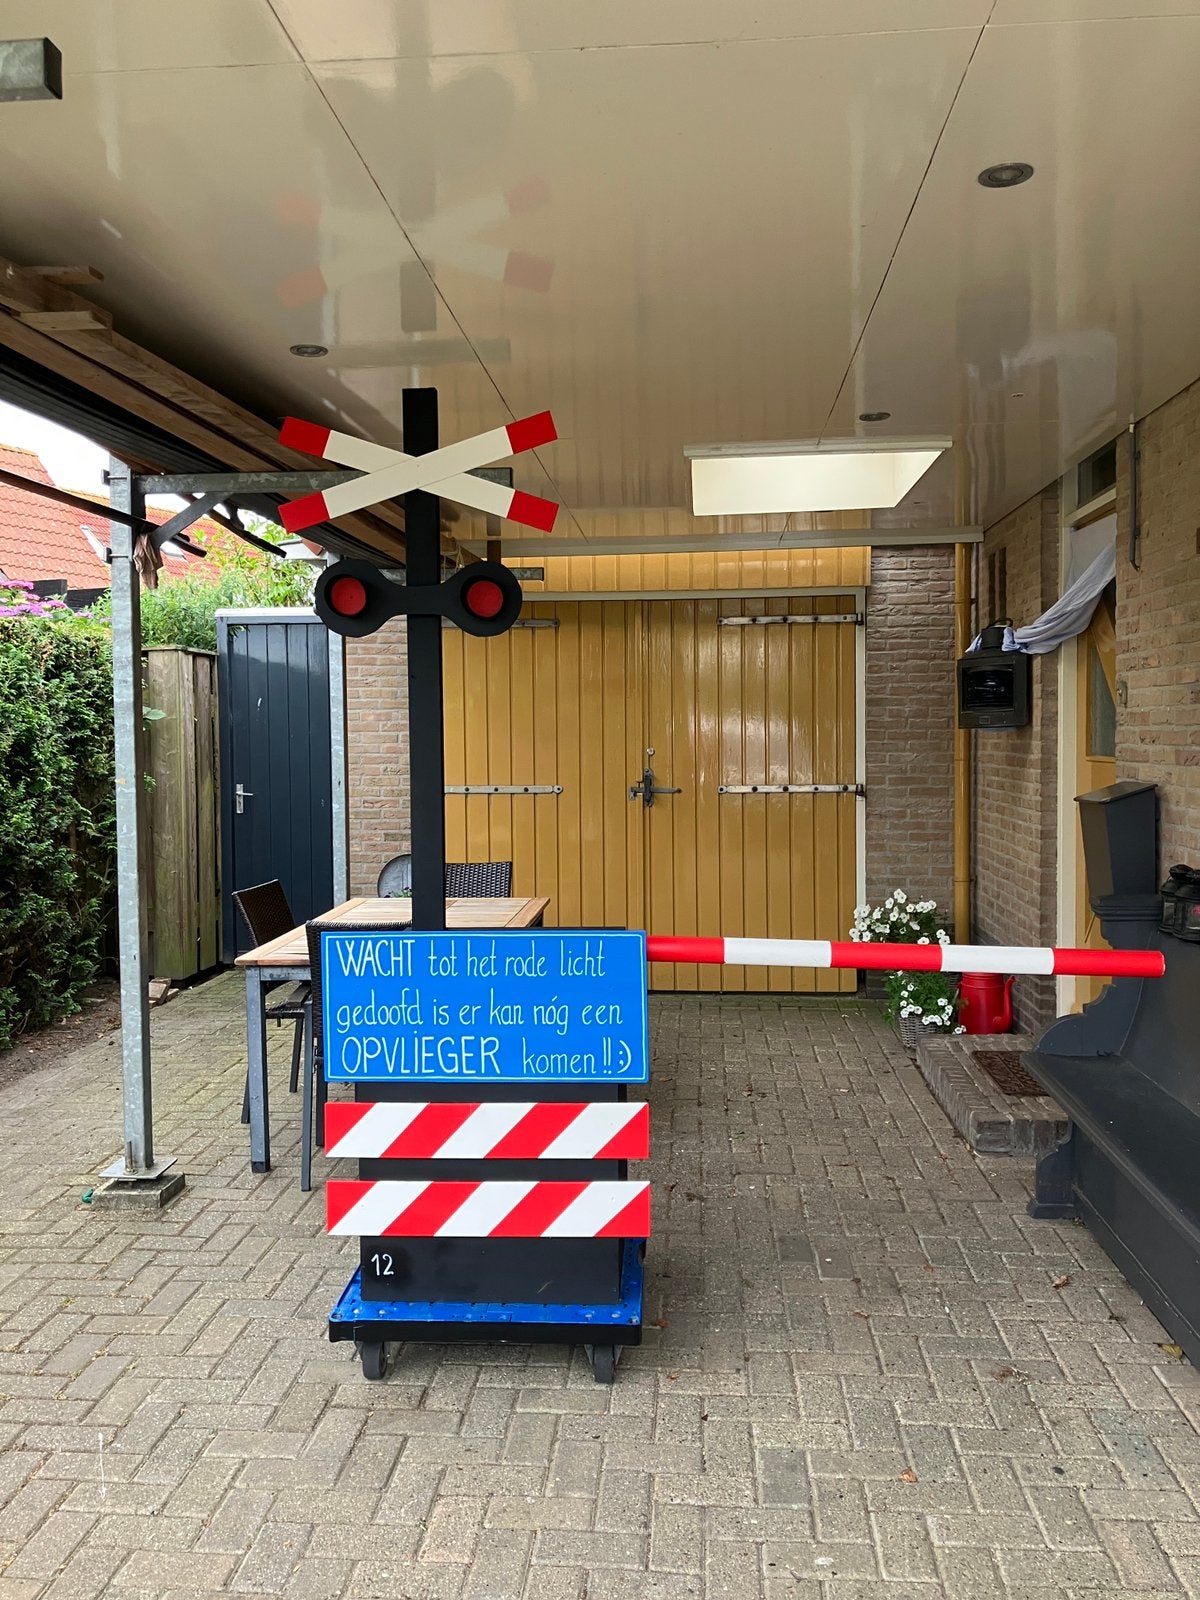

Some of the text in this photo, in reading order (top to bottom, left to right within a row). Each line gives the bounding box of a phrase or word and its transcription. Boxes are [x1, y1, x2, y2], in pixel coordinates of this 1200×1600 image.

[336, 940, 606, 977] WACHT tot het rode licht
[337, 988, 623, 1035] gedoofd is er kan nóg een
[371, 1253, 394, 1276] 12
